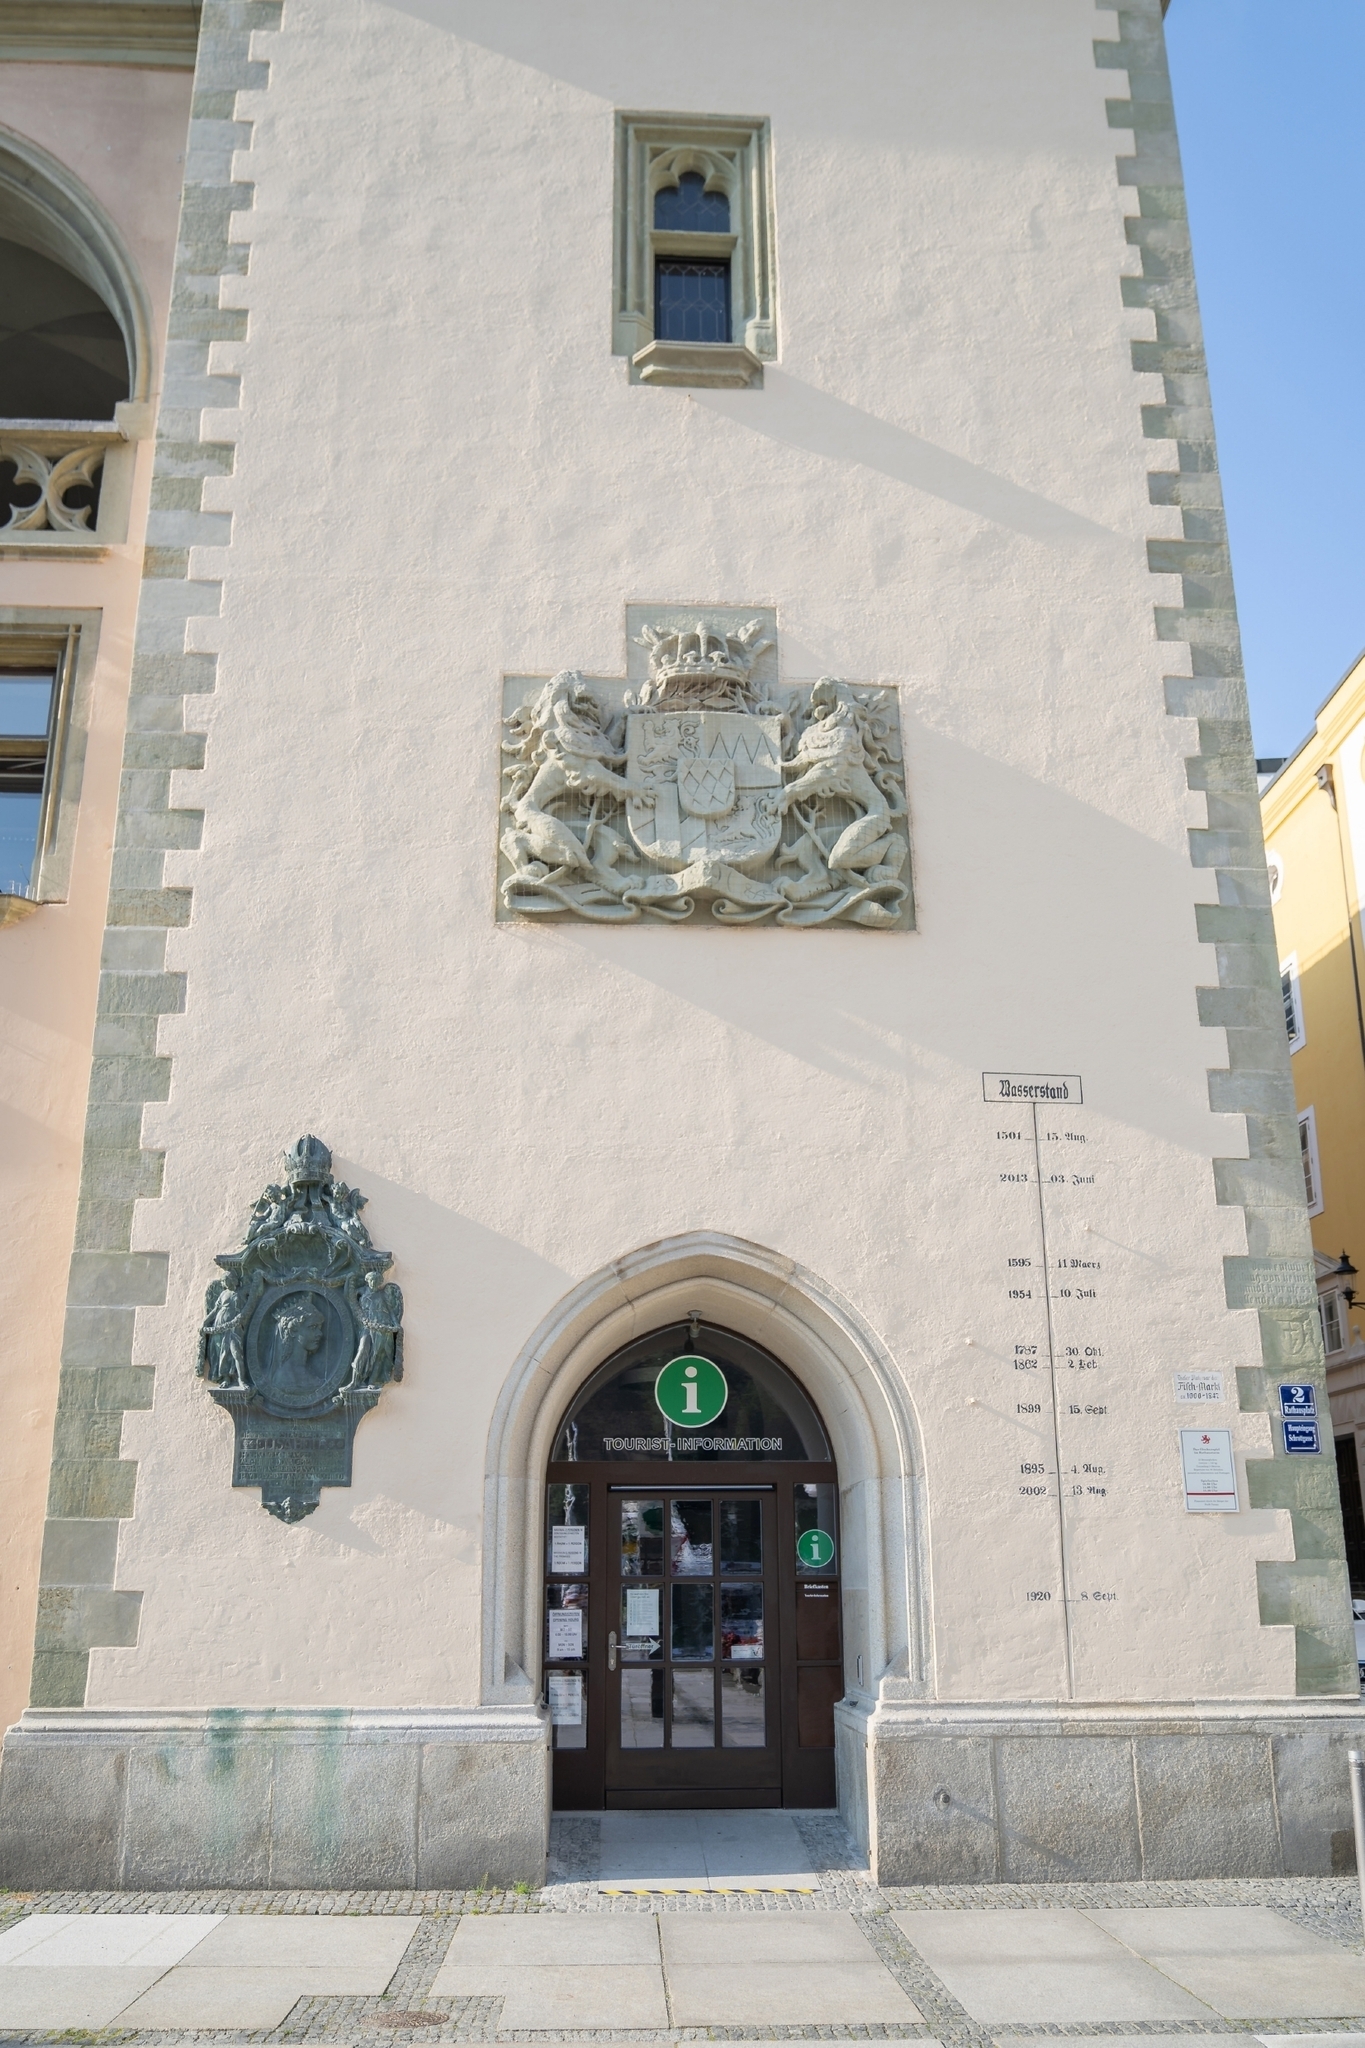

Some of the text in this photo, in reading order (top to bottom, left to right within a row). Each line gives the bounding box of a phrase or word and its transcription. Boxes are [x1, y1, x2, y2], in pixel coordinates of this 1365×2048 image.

[999, 1079, 1069, 1100] Wasserstand
[996, 1131, 1089, 1144] 1501 15. Aug.
[999, 1173, 1095, 1186] 2013 03. Juni
[1007, 1258, 1031, 1267] 1595
[1070, 1258, 1101, 1270] Maerz
[1008, 1289, 1032, 1299] 1954
[1076, 1288, 1097, 1300] Juli
[1014, 1345, 1038, 1355] 1787
[1013, 1359, 1038, 1370] 1862
[1290, 1386, 1305, 1403] 2
[1016, 1403, 1041, 1414] 1899
[1020, 1463, 1045, 1474] 1895
[1018, 1486, 1047, 1496] 2002
[1086, 1486, 1109, 1497] Aug.
[1026, 1591, 1051, 1601] 1920
